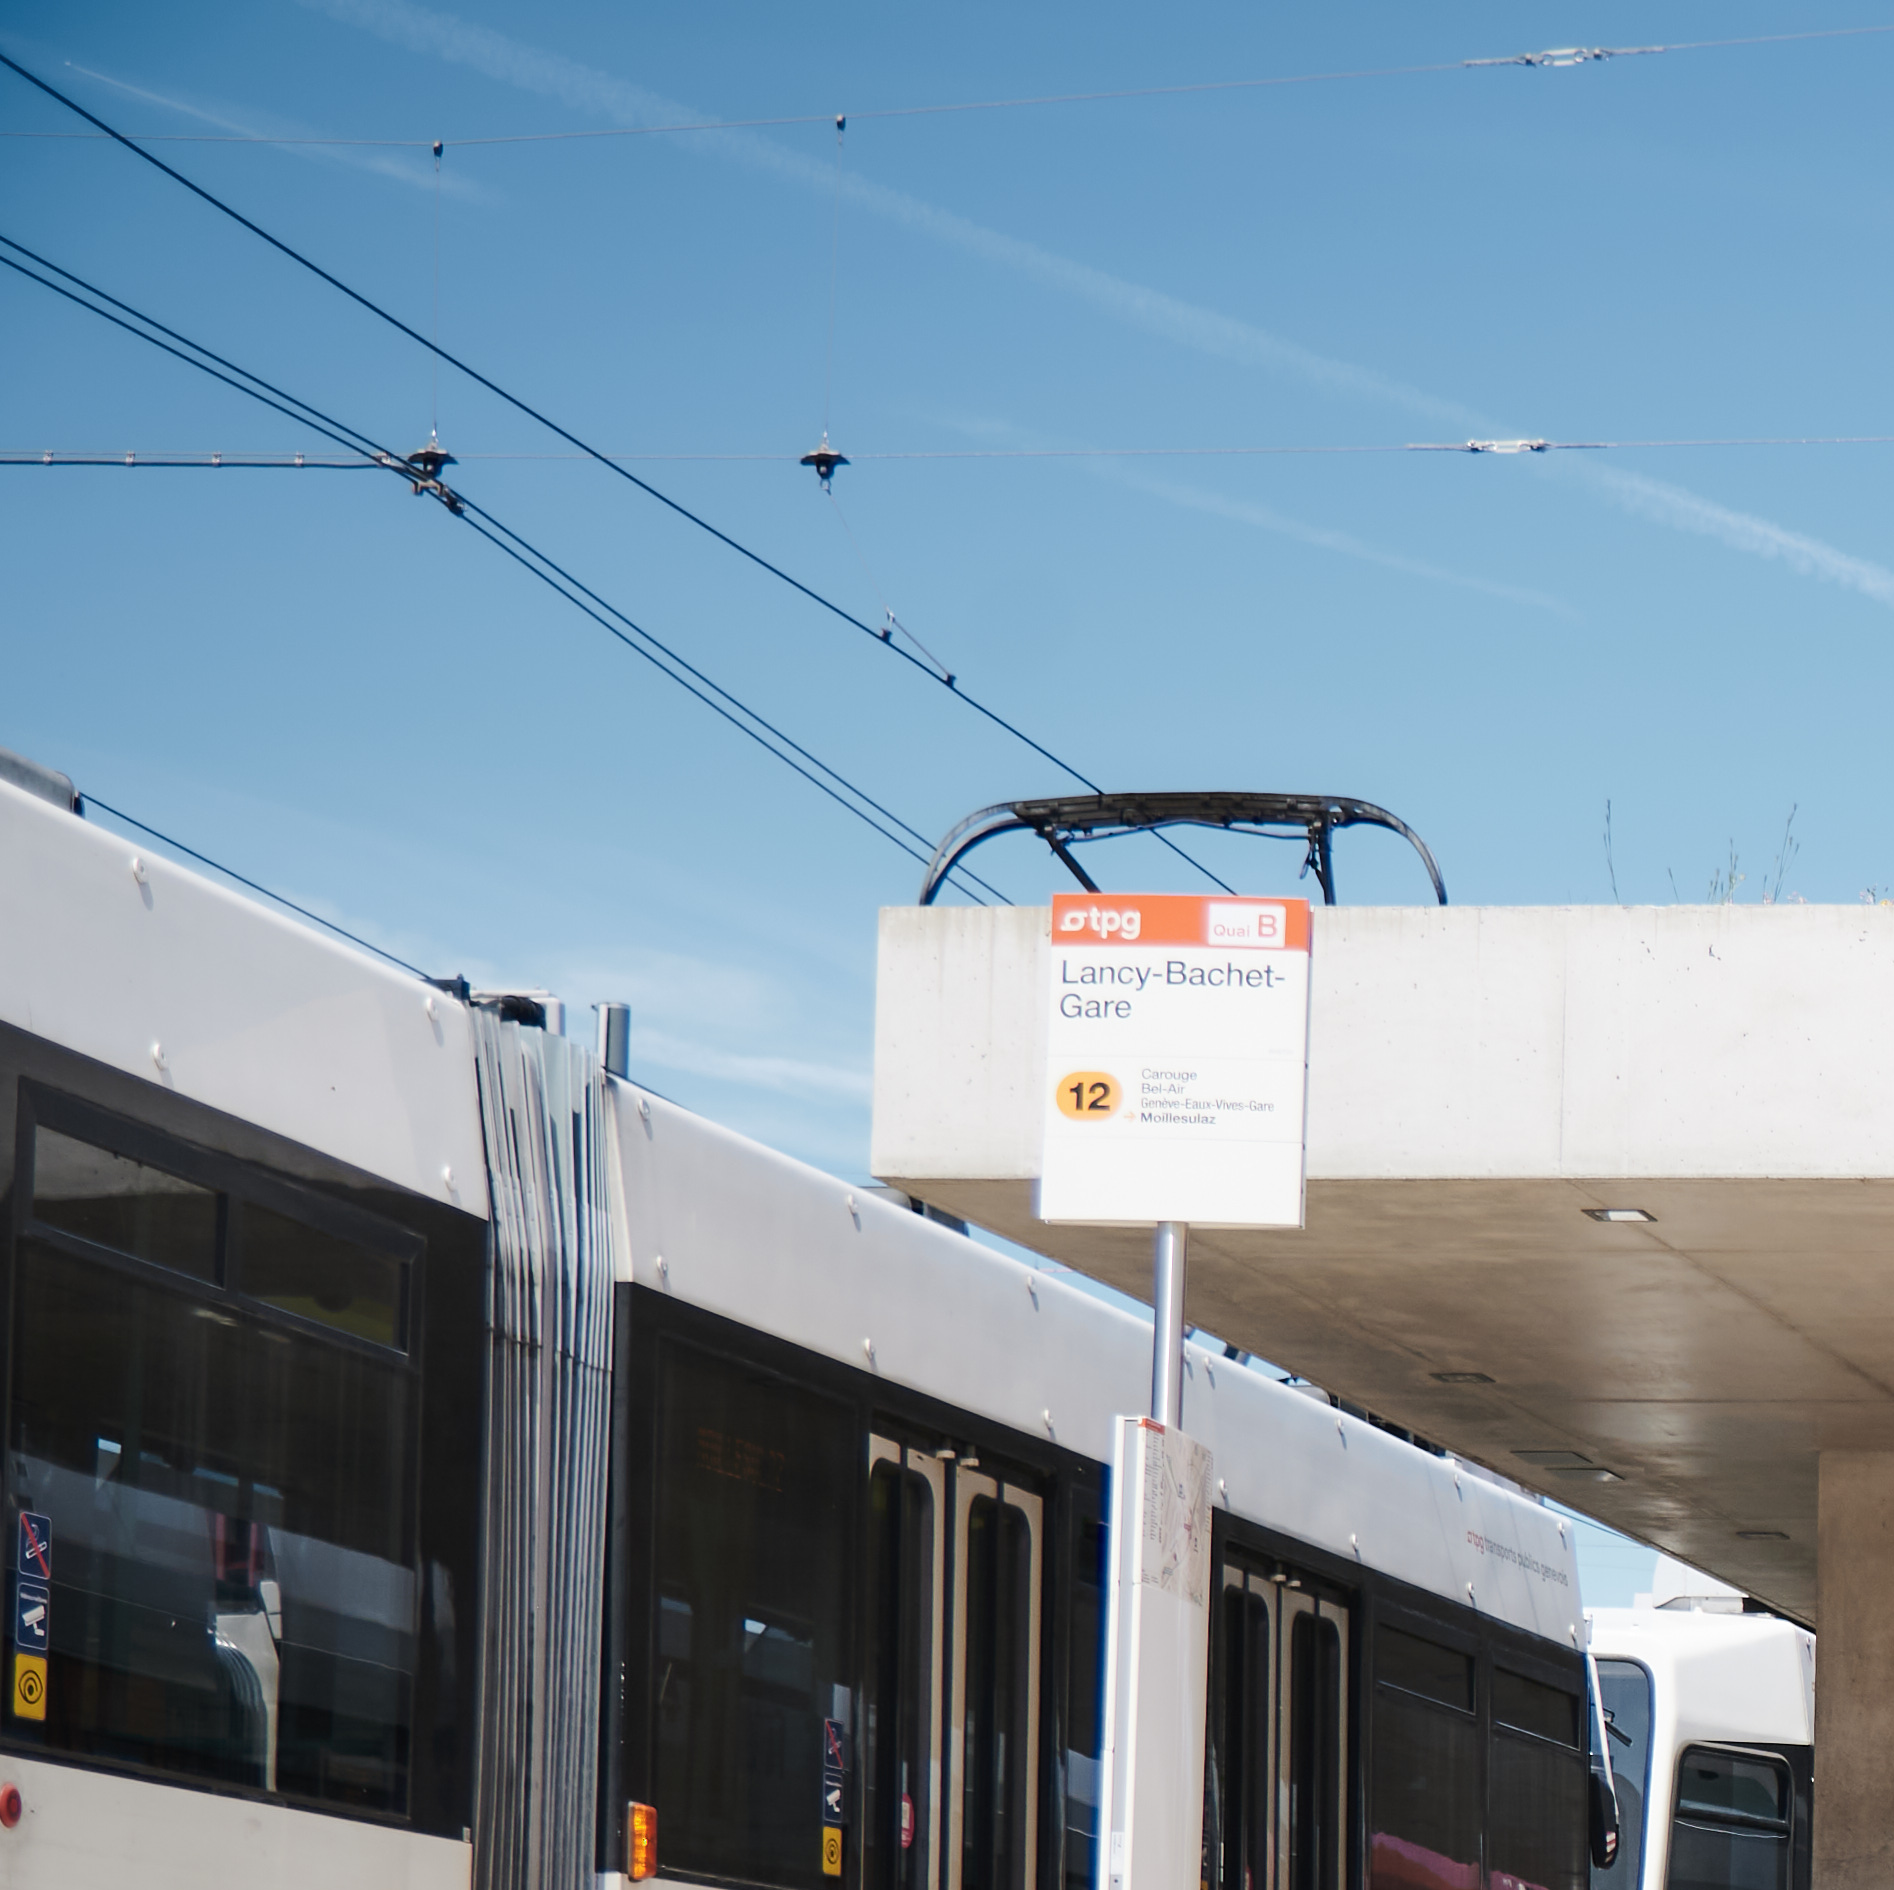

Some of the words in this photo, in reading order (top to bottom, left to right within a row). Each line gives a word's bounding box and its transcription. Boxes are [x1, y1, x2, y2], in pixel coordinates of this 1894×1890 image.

[1089, 907, 1141, 940] tpg
[1213, 923, 1250, 939] Quai
[1258, 914, 1277, 938] B
[1062, 960, 1286, 991] Lancy-Bachet-
[1059, 993, 1132, 1019] Gare
[1141, 1068, 1198, 1083] Carouge
[1069, 1082, 1111, 1112] 12
[1141, 1083, 1186, 1096] Bel-Air
[1140, 1112, 1217, 1125] Moillesulaz
